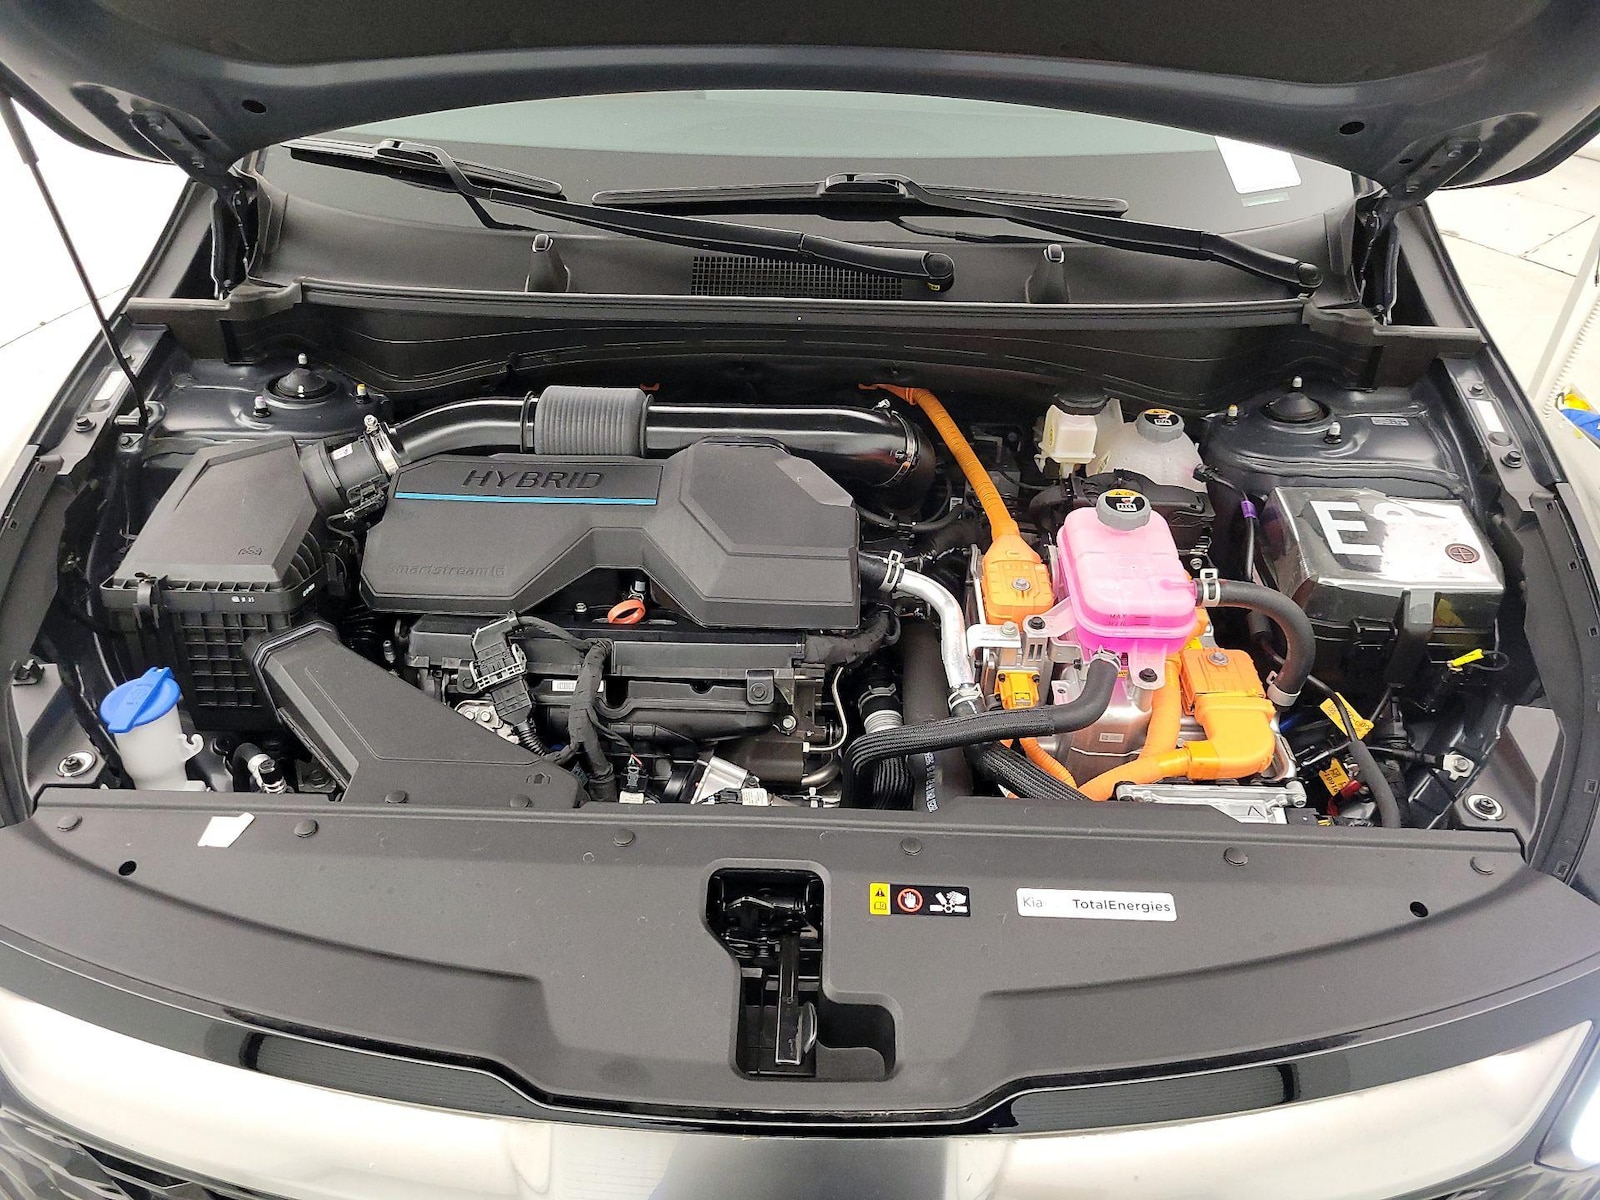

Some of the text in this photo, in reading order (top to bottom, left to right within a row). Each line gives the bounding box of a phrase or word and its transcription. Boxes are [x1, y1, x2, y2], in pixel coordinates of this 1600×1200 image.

[462, 469, 605, 489] HYBRID
[1022, 896, 1171, 913] Kia TotalEnergies
